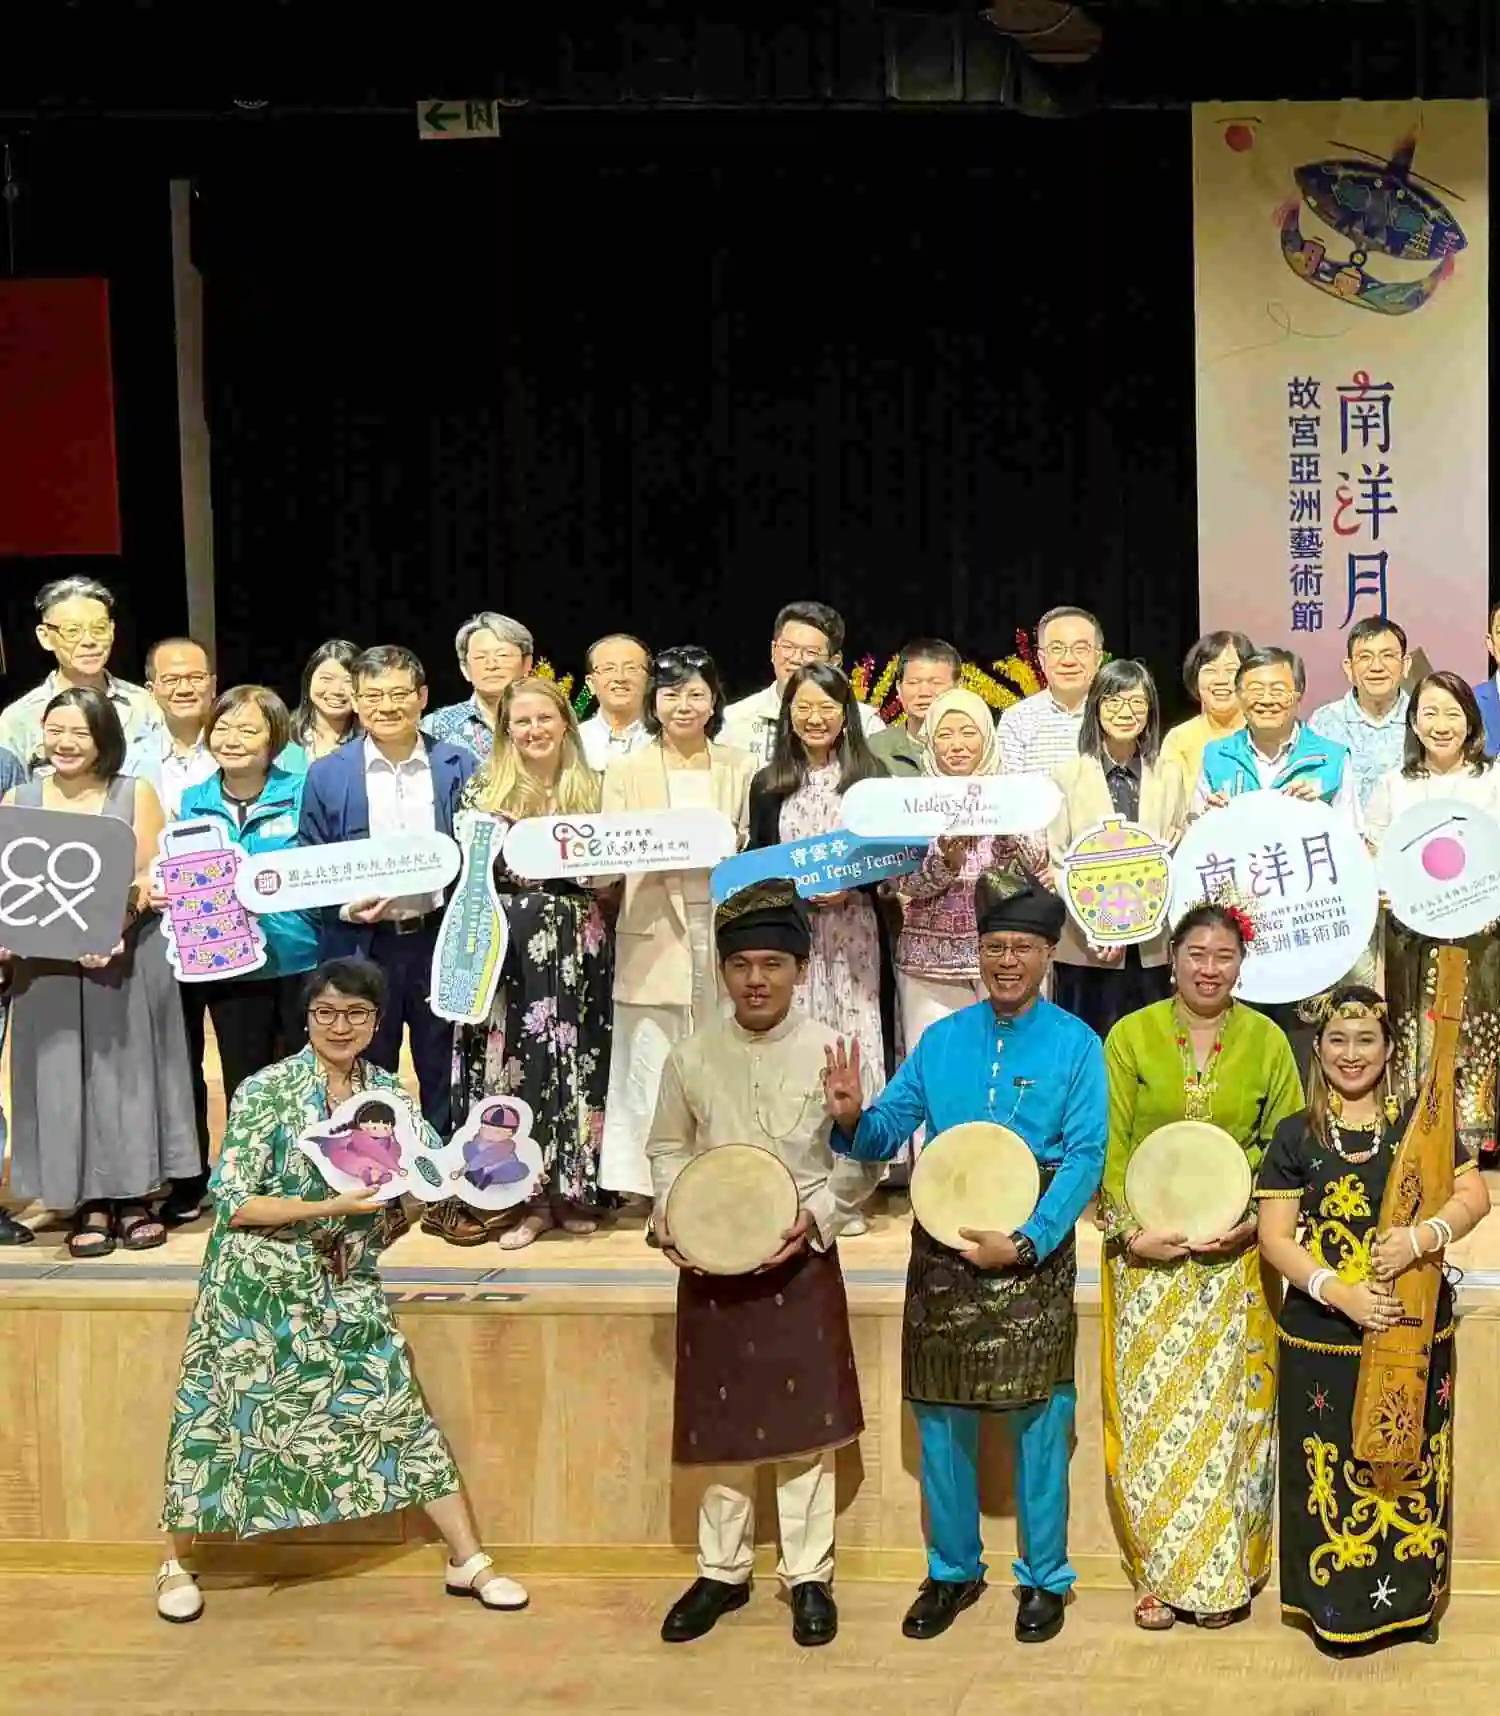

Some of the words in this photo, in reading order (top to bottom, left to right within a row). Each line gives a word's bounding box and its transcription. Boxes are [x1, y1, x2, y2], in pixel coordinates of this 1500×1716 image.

[1288, 376, 1323, 633] 故宮亞洲藝術節
[1333, 370, 1398, 630] 南洋月
[822, 861, 863, 879] Teng
